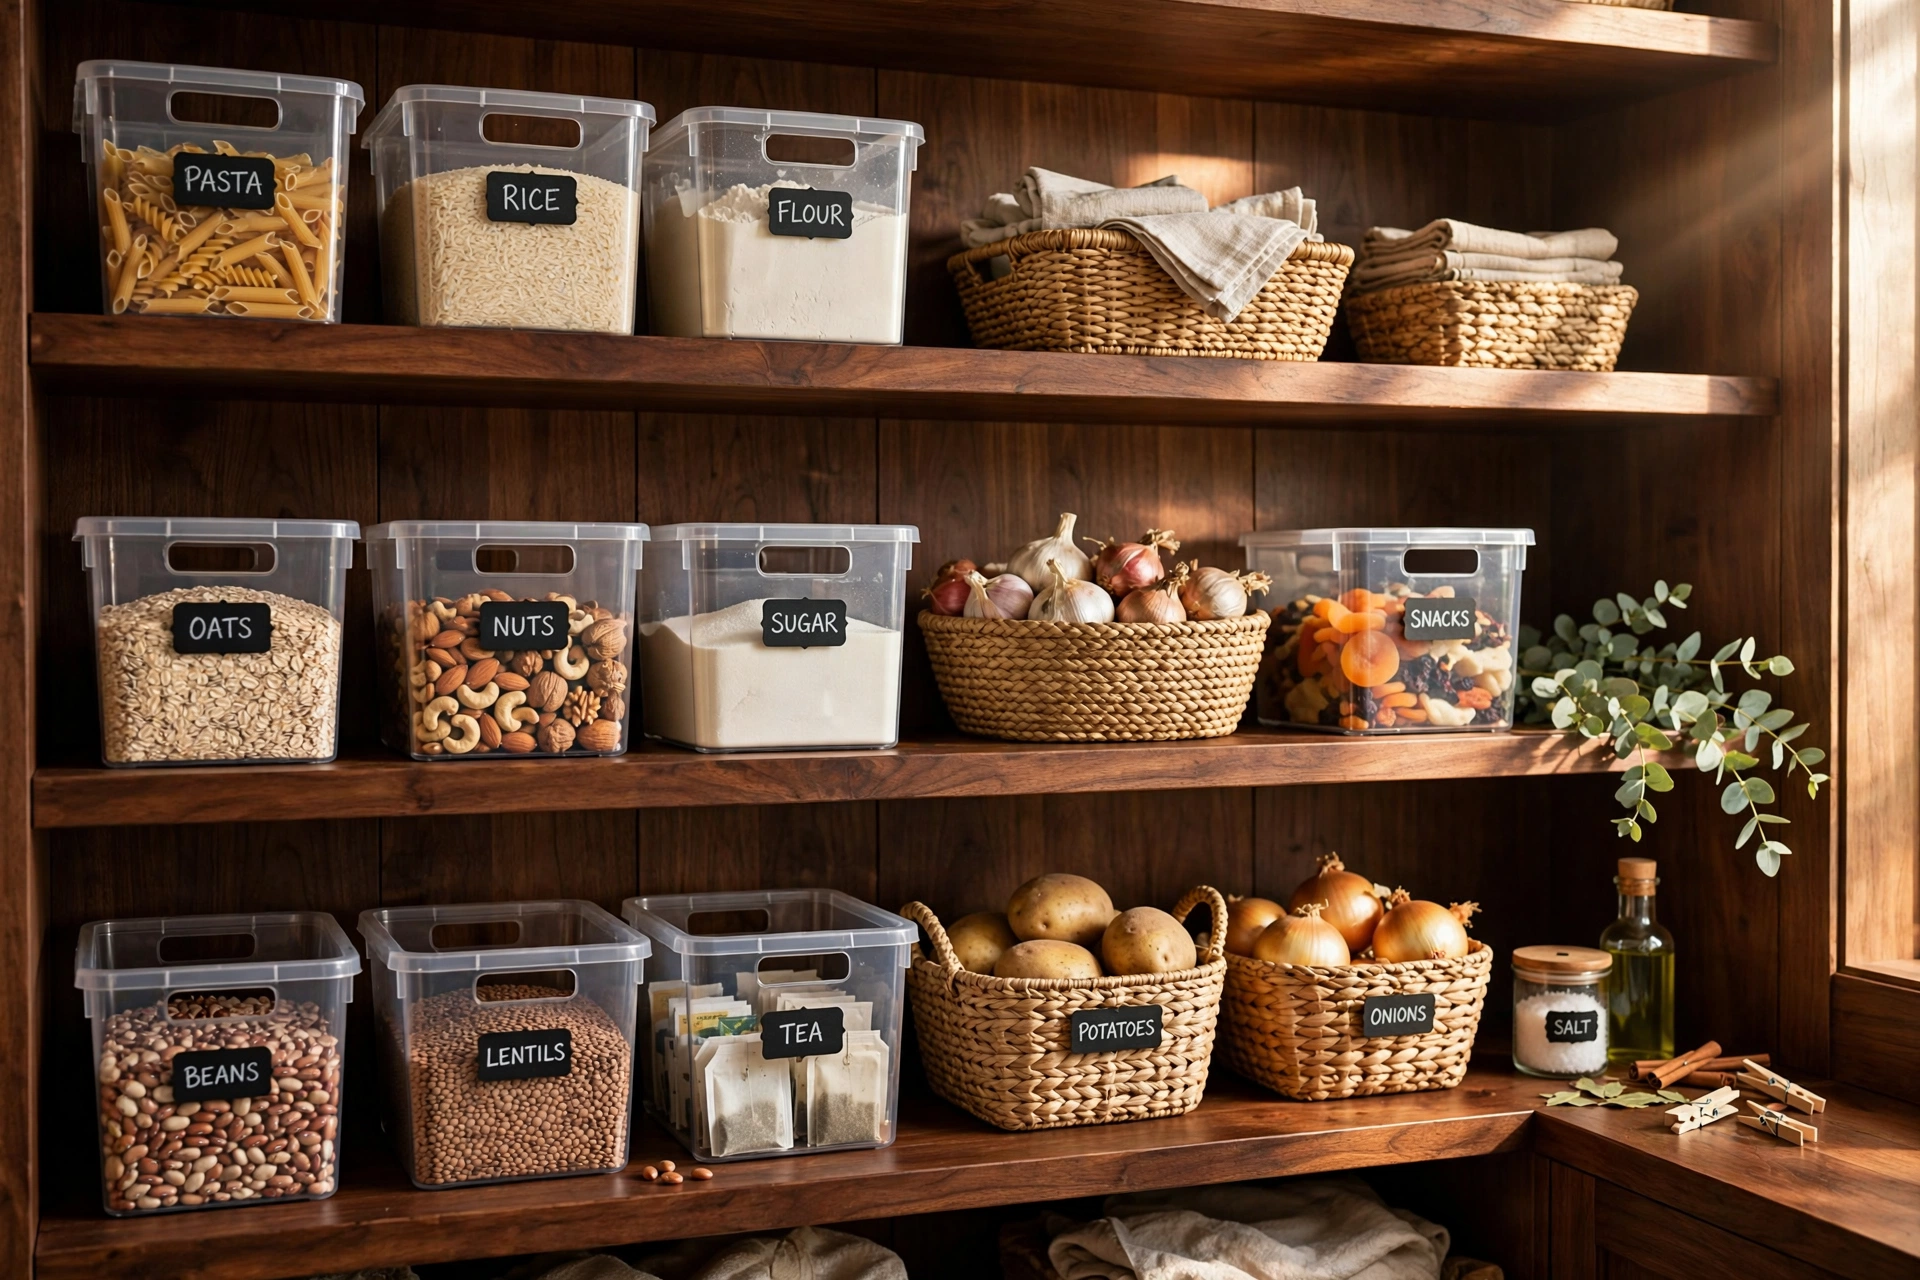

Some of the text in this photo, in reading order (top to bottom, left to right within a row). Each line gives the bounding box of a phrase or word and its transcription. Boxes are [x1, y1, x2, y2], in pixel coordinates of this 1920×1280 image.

[184, 165, 262, 196] PASTA
[502, 183, 560, 211] RICE
[778, 199, 845, 227] FLOUR
[189, 616, 252, 640] OATS
[493, 614, 555, 637] NUTS
[771, 611, 839, 634] SUGAR
[1410, 608, 1470, 629] SNACKS
[1370, 1004, 1427, 1026] ONIONS
[1554, 1017, 1592, 1035] SALT
[778, 1021, 823, 1045] TEA
[1078, 1018, 1155, 1042] POTATOES
[486, 1042, 566, 1068] LENTILS
[184, 1061, 259, 1089] BEANS
